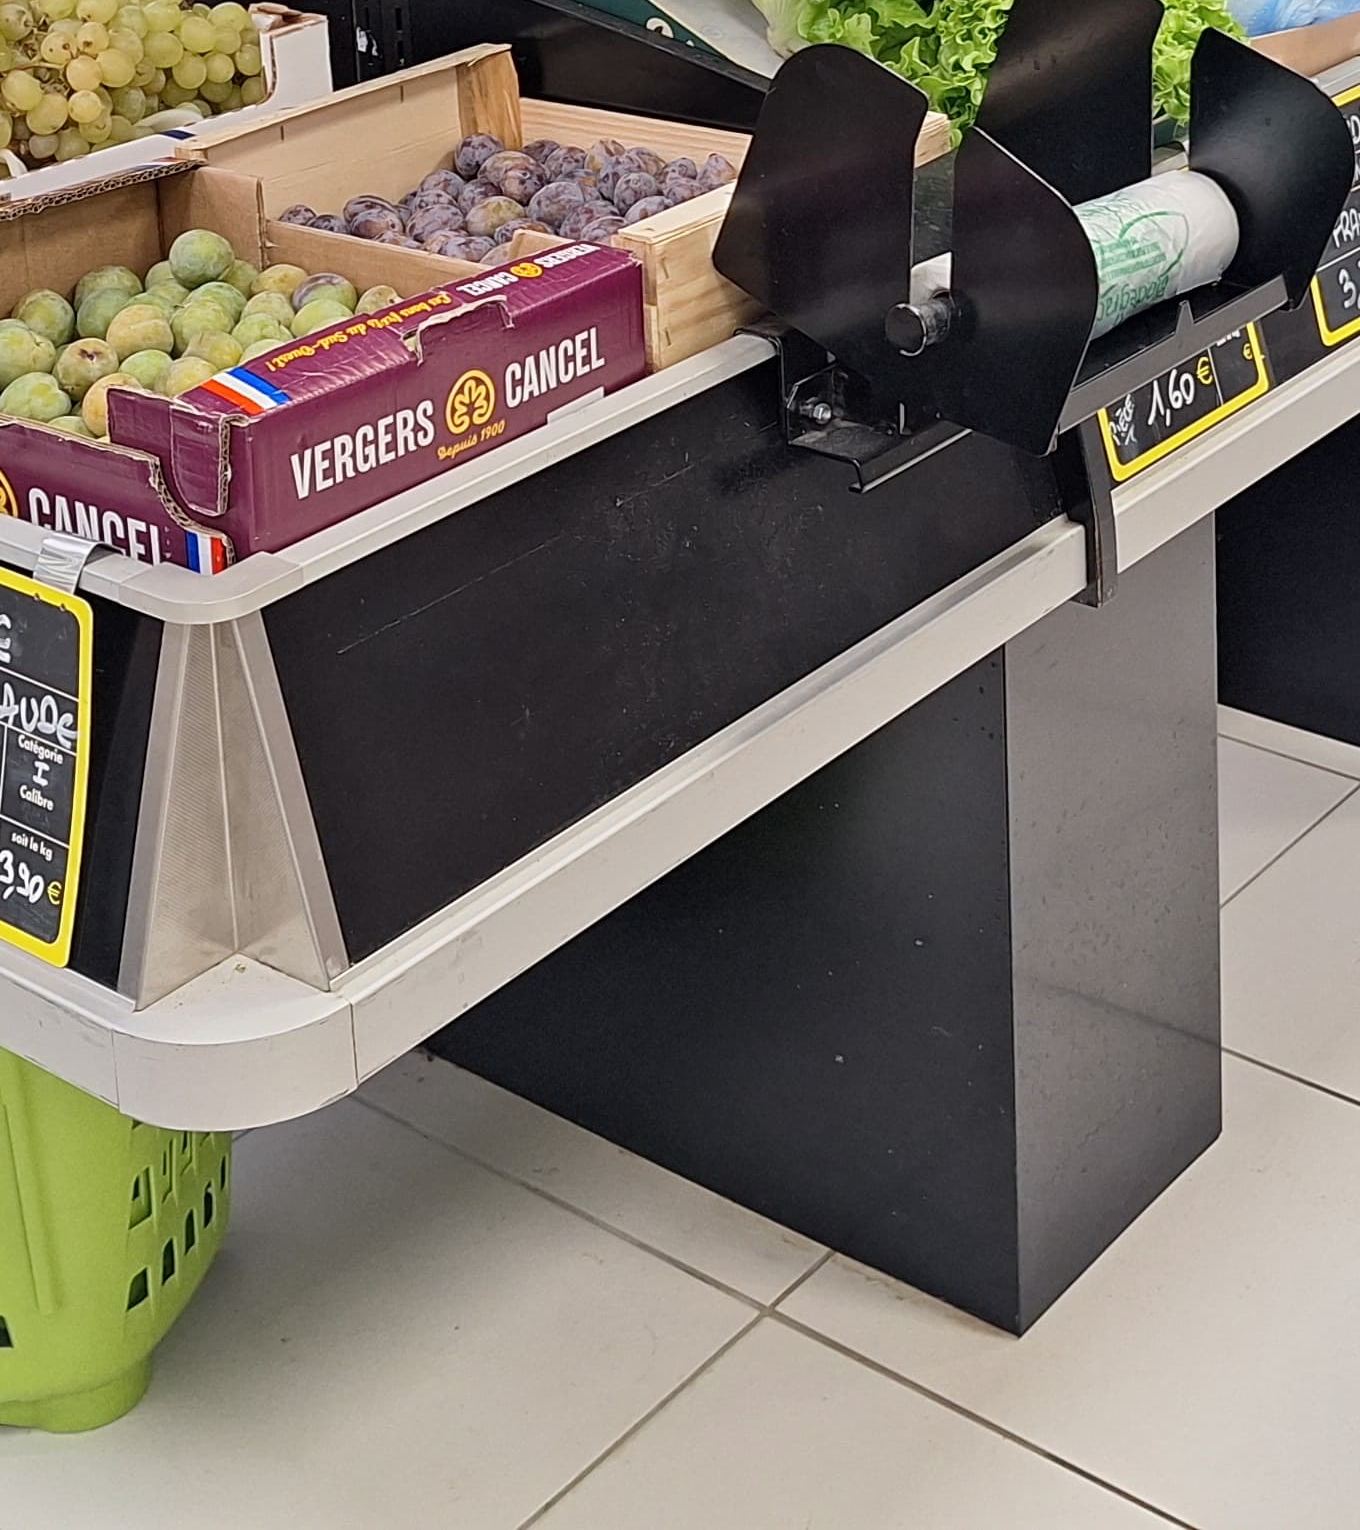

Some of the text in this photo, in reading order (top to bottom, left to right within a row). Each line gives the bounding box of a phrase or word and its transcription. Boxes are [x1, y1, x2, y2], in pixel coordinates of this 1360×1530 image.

[504, 326, 606, 409] CANCEL
[1147, 367, 1196, 428] 1,60
[290, 398, 436, 501] VERGERS
[437, 419, 506, 461] Depuis 1900
[17, 734, 64, 765] Catégorie
[18, 784, 54, 811] Calibre
[46, 880, 63, 905] €
